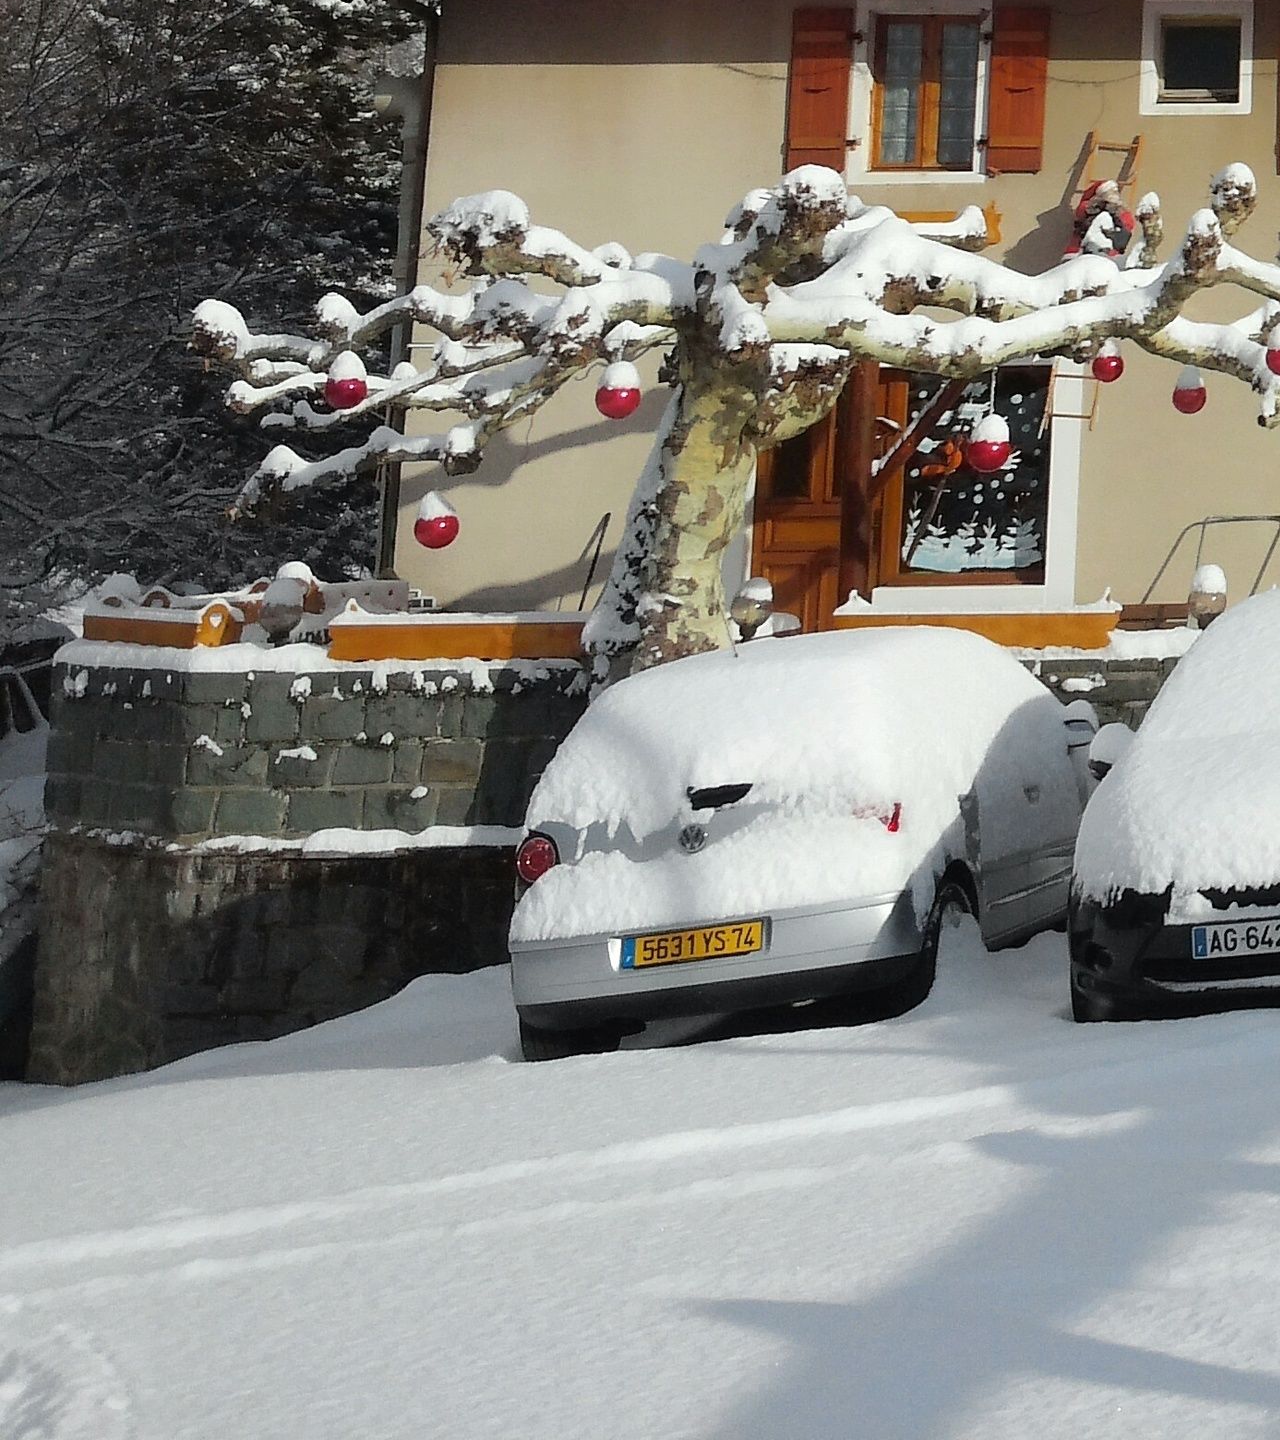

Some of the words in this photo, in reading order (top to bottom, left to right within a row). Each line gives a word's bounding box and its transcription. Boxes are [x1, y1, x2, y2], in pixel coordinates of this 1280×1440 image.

[643, 936, 695, 961] 5631
[703, 931, 726, 954] YS
[732, 926, 755, 948] 74
